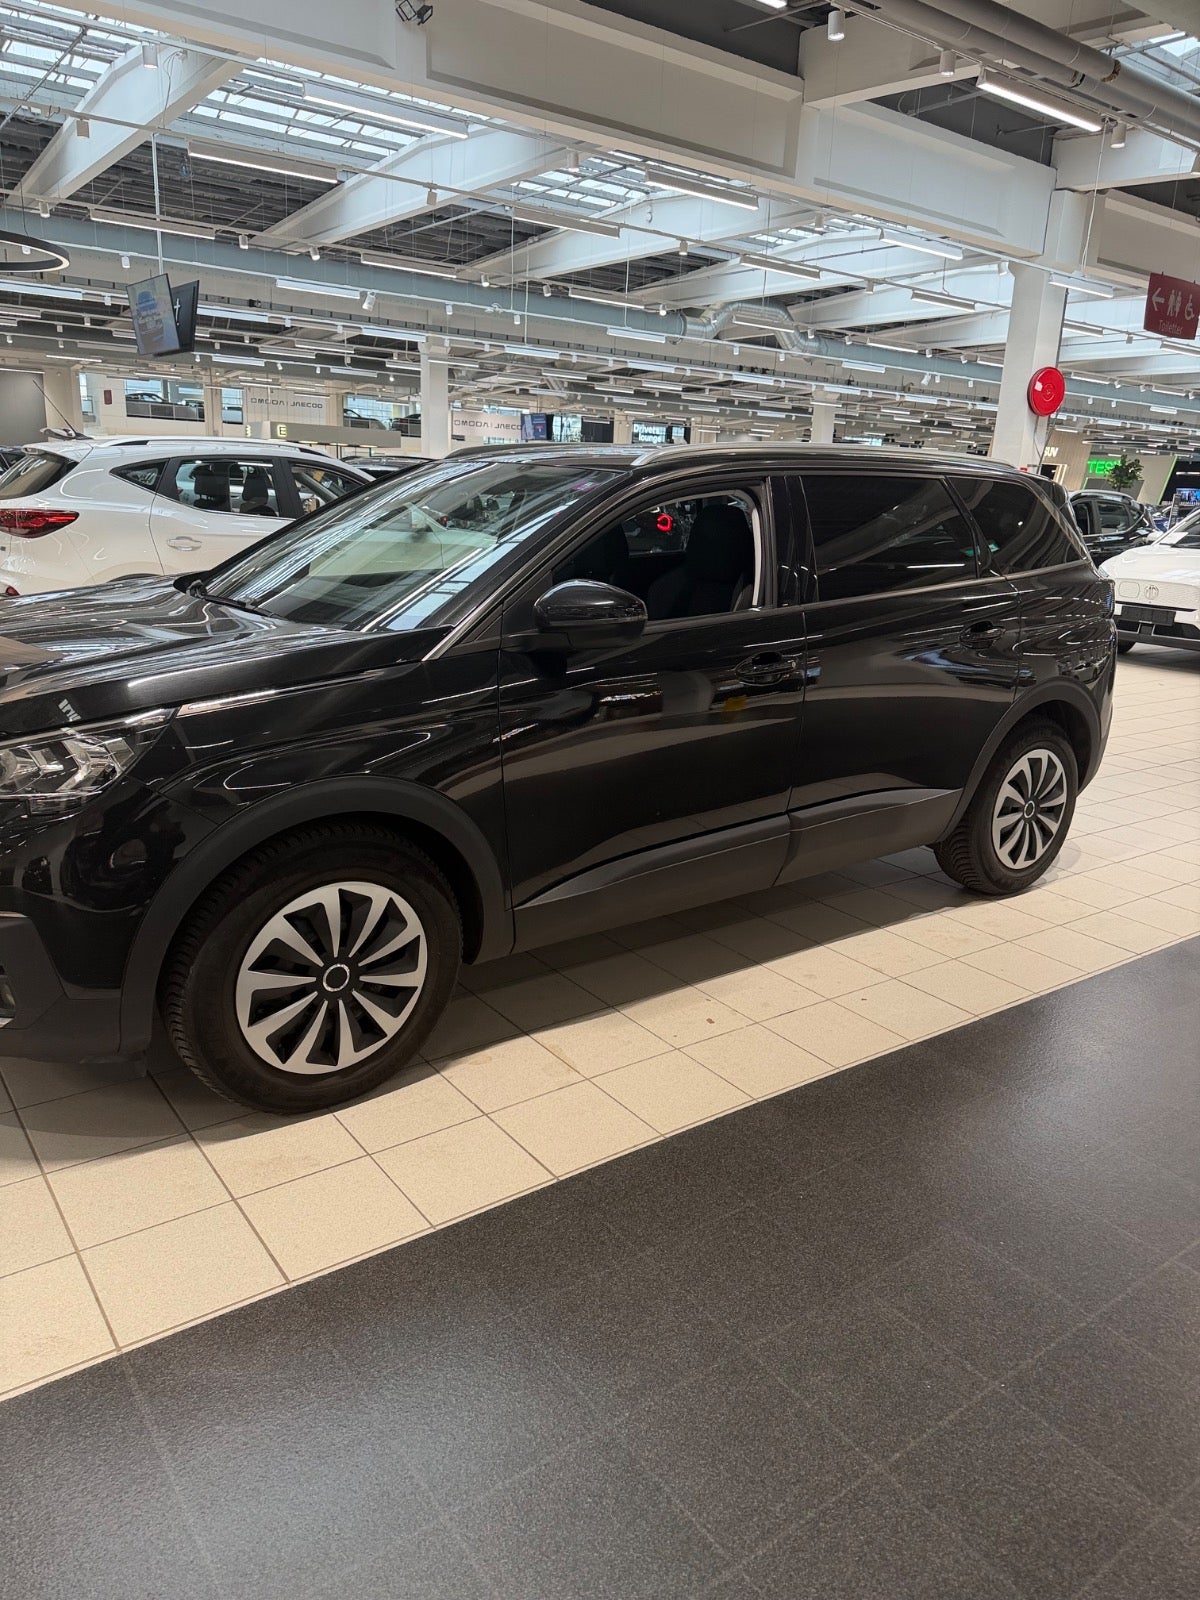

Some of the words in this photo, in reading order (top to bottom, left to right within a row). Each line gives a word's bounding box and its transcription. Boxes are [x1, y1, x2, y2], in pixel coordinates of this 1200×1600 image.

[1159, 319, 1183, 335] Toiletter
[251, 397, 284, 406] OMODA
[290, 400, 323, 409] JAECOO
[277, 424, 287, 437] E
[454, 419, 489, 428] OMODA
[494, 422, 522, 431] JAECO
